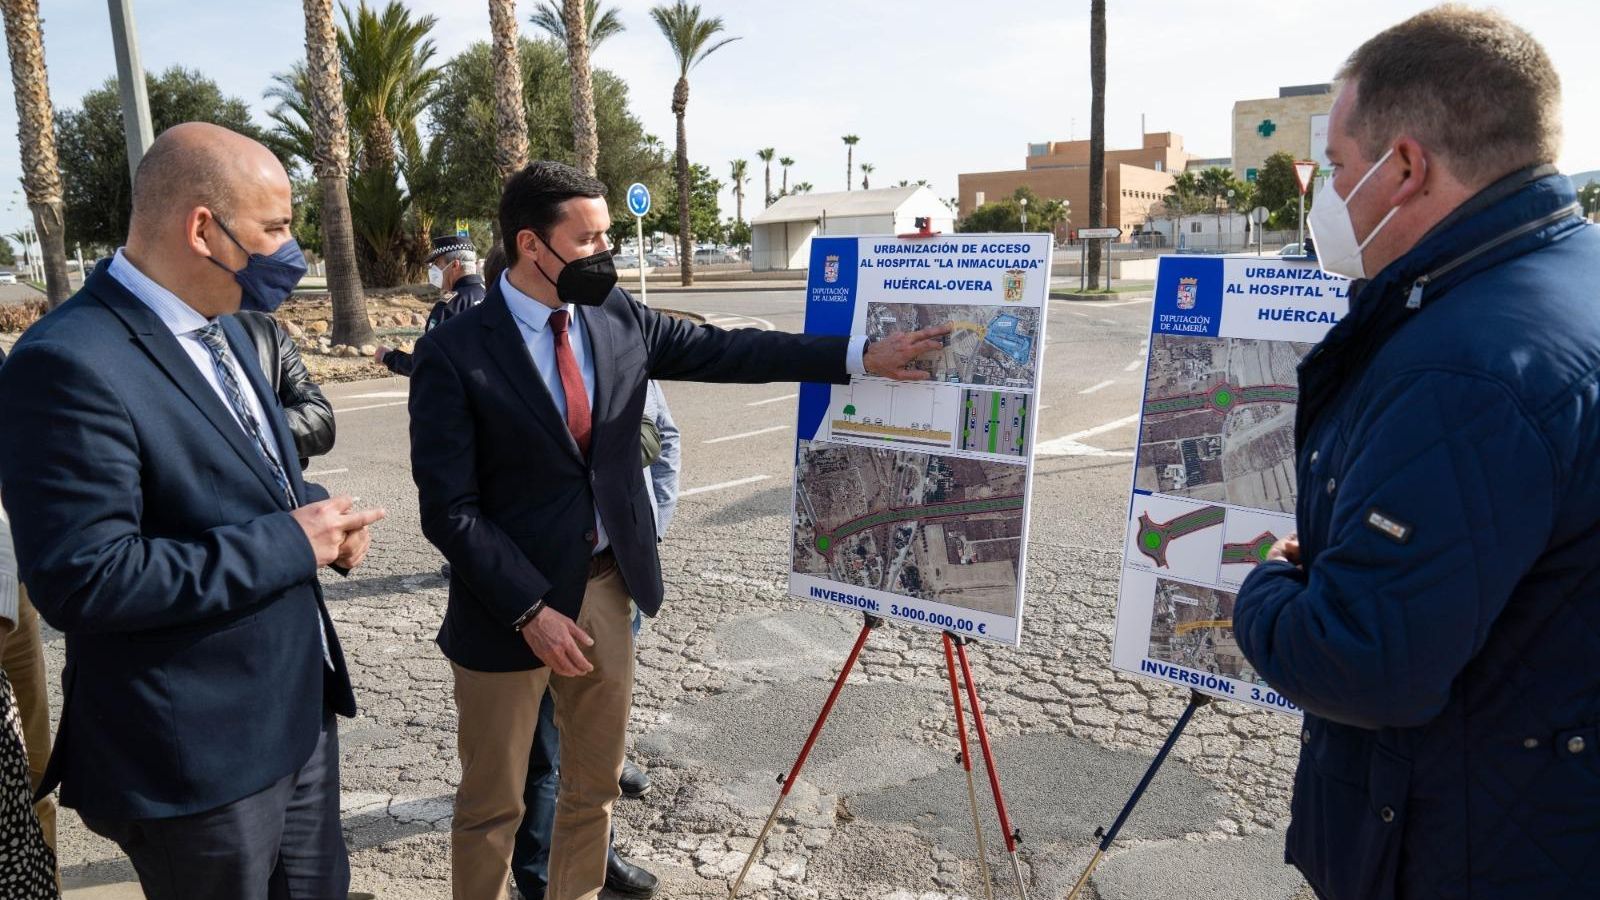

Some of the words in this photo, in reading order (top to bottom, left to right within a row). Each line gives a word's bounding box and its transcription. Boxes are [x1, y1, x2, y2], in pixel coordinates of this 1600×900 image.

[874, 242, 958, 254] URBANIZACIÓN
[962, 244, 977, 253] DE
[981, 244, 1031, 254] ACCESO
[860, 258, 873, 268] AL
[877, 258, 931, 268] HOSPITAL
[934, 259, 953, 268] "LA
[957, 259, 1044, 269] INMACULADA"
[1245, 268, 1348, 281] URBANIZAC
[883, 277, 993, 291] HUÉRCAL-OVERA
[812, 287, 849, 295] DIPUTACIÓN
[1226, 284, 1244, 294] AL
[1249, 284, 1323, 297] HOSPITAL
[822, 294, 848, 302] ALMERÍA
[1160, 314, 1210, 324] DIPUTACIÓN
[1172, 323, 1208, 333] ALMERÍA
[810, 586, 880, 612] INVERSIÓN:
[890, 604, 974, 631] 3.000.000,00
[978, 623, 986, 635] €
[1141, 660, 1235, 695] INVERSIÓN:
